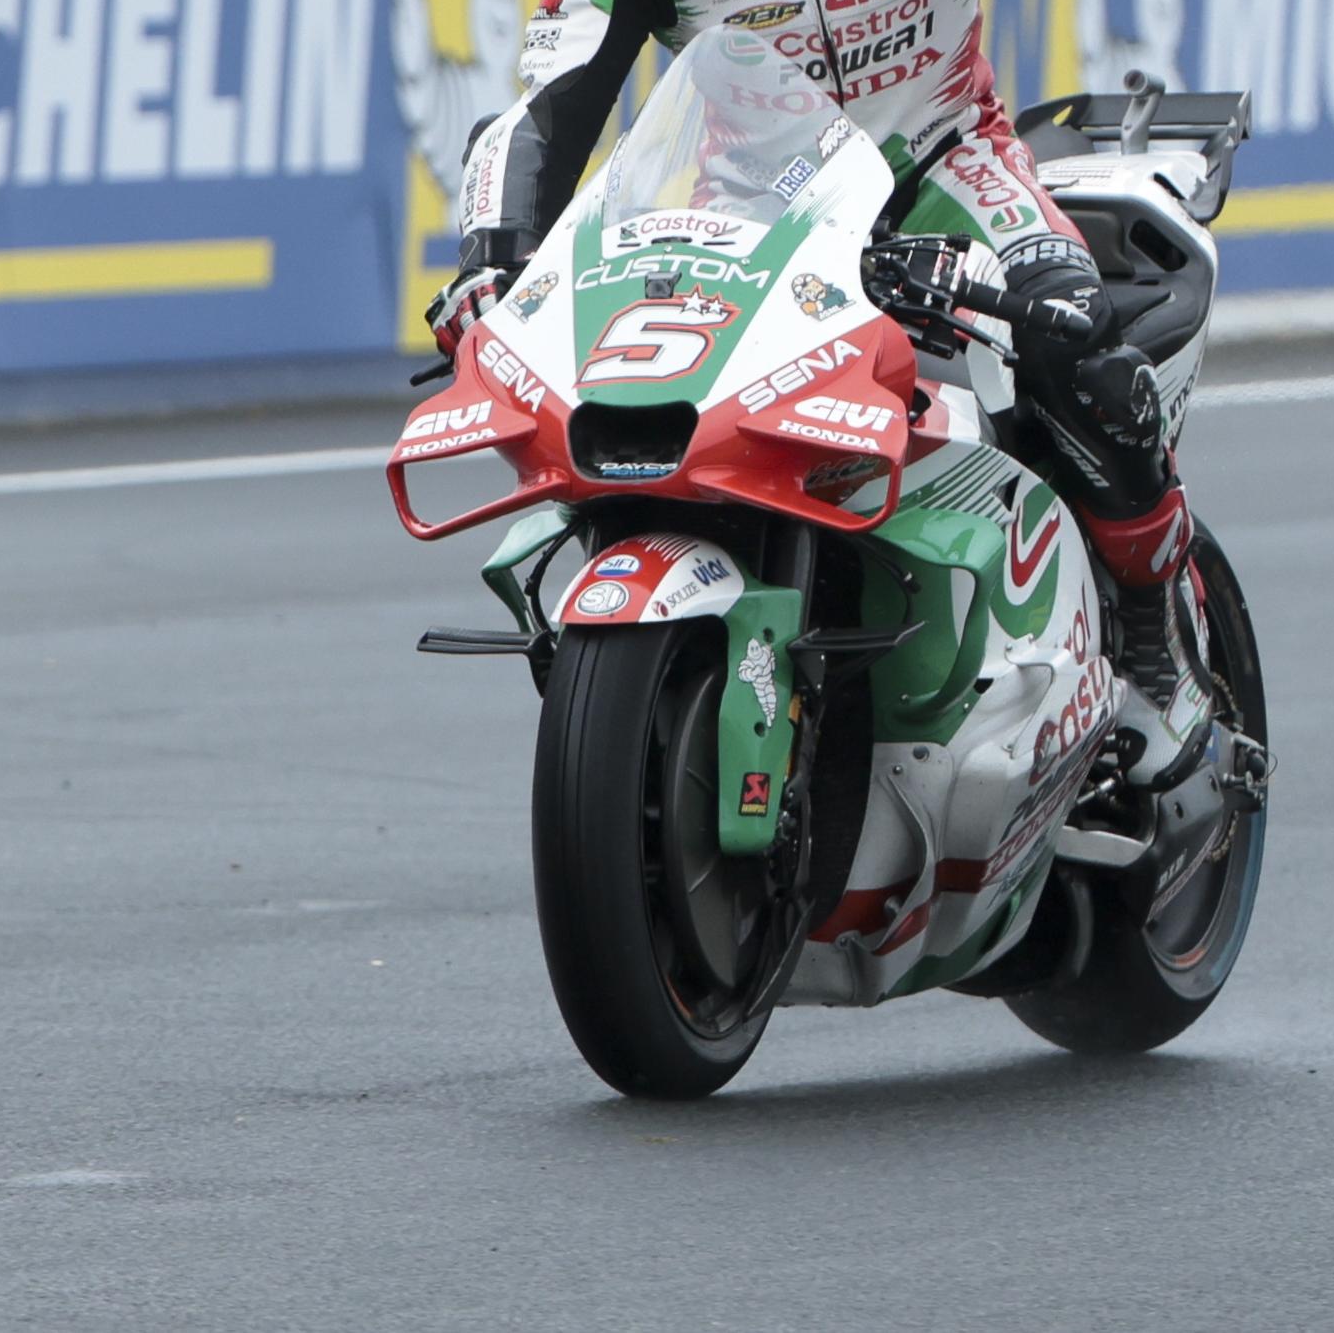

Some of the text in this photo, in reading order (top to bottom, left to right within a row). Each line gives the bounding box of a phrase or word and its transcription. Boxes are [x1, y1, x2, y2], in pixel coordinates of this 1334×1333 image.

[728, 46, 946, 115] HONDA
[475, 144, 499, 218] Castrol
[639, 214, 735, 237] Castrol
[575, 254, 772, 291] CUSTOM
[477, 338, 547, 413] SENA
[738, 339, 863, 414] SENA
[401, 399, 493, 440] GIVI
[794, 395, 896, 433] GIVI
[400, 427, 497, 458] HONDA
[777, 419, 881, 451] HONDA
[666, 581, 702, 608] SOLIZE
